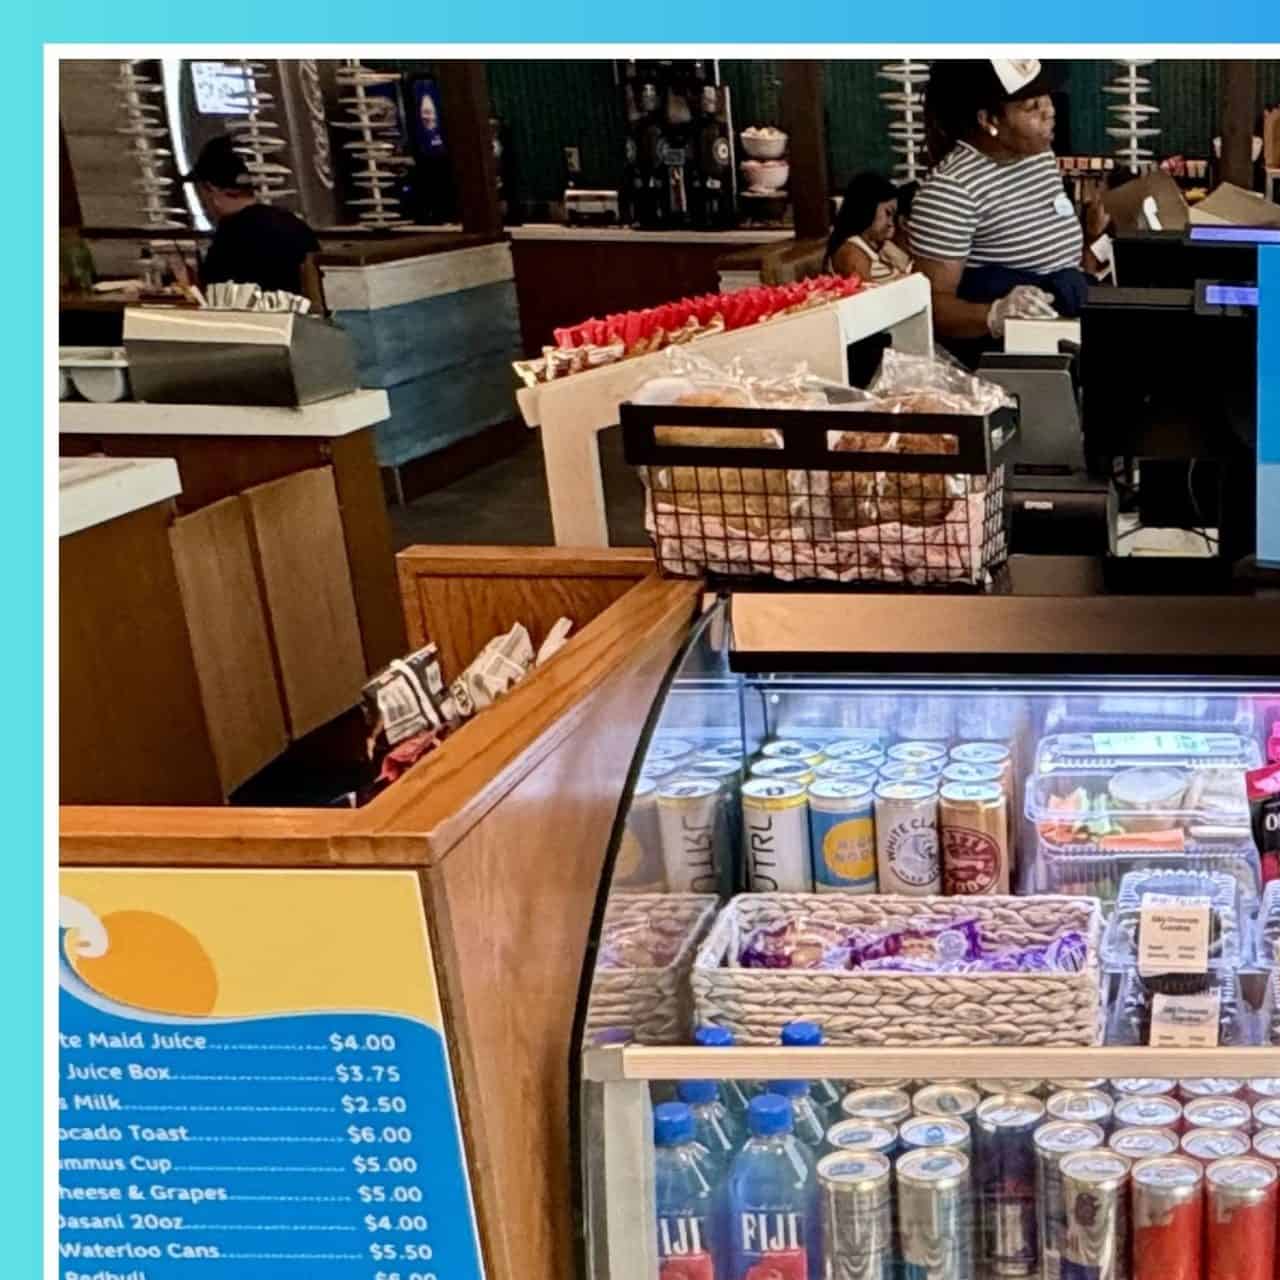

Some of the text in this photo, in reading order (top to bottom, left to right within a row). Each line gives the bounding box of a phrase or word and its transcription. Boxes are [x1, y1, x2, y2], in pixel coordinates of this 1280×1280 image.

[910, 817, 939, 830] CLA
[750, 814, 778, 893] UTRL
[88, 1032, 144, 1049] Maid
[152, 1033, 206, 1050] Juice
[329, 1033, 395, 1052] $4.00
[68, 1063, 400, 1083] Juice Box $3.75
[74, 1094, 122, 1110] Milk
[341, 1095, 406, 1113] $2.50
[59, 1124, 412, 1143] ocado Toast $6.00
[130, 1155, 172, 1174] Cup
[352, 1155, 417, 1174] $5.00
[59, 1184, 422, 1204] heese & Grapes $5.00
[130, 1214, 183, 1230] 20oz
[364, 1214, 427, 1232] $4.00
[59, 1242, 433, 1260] Waterloo Cans $5.50
